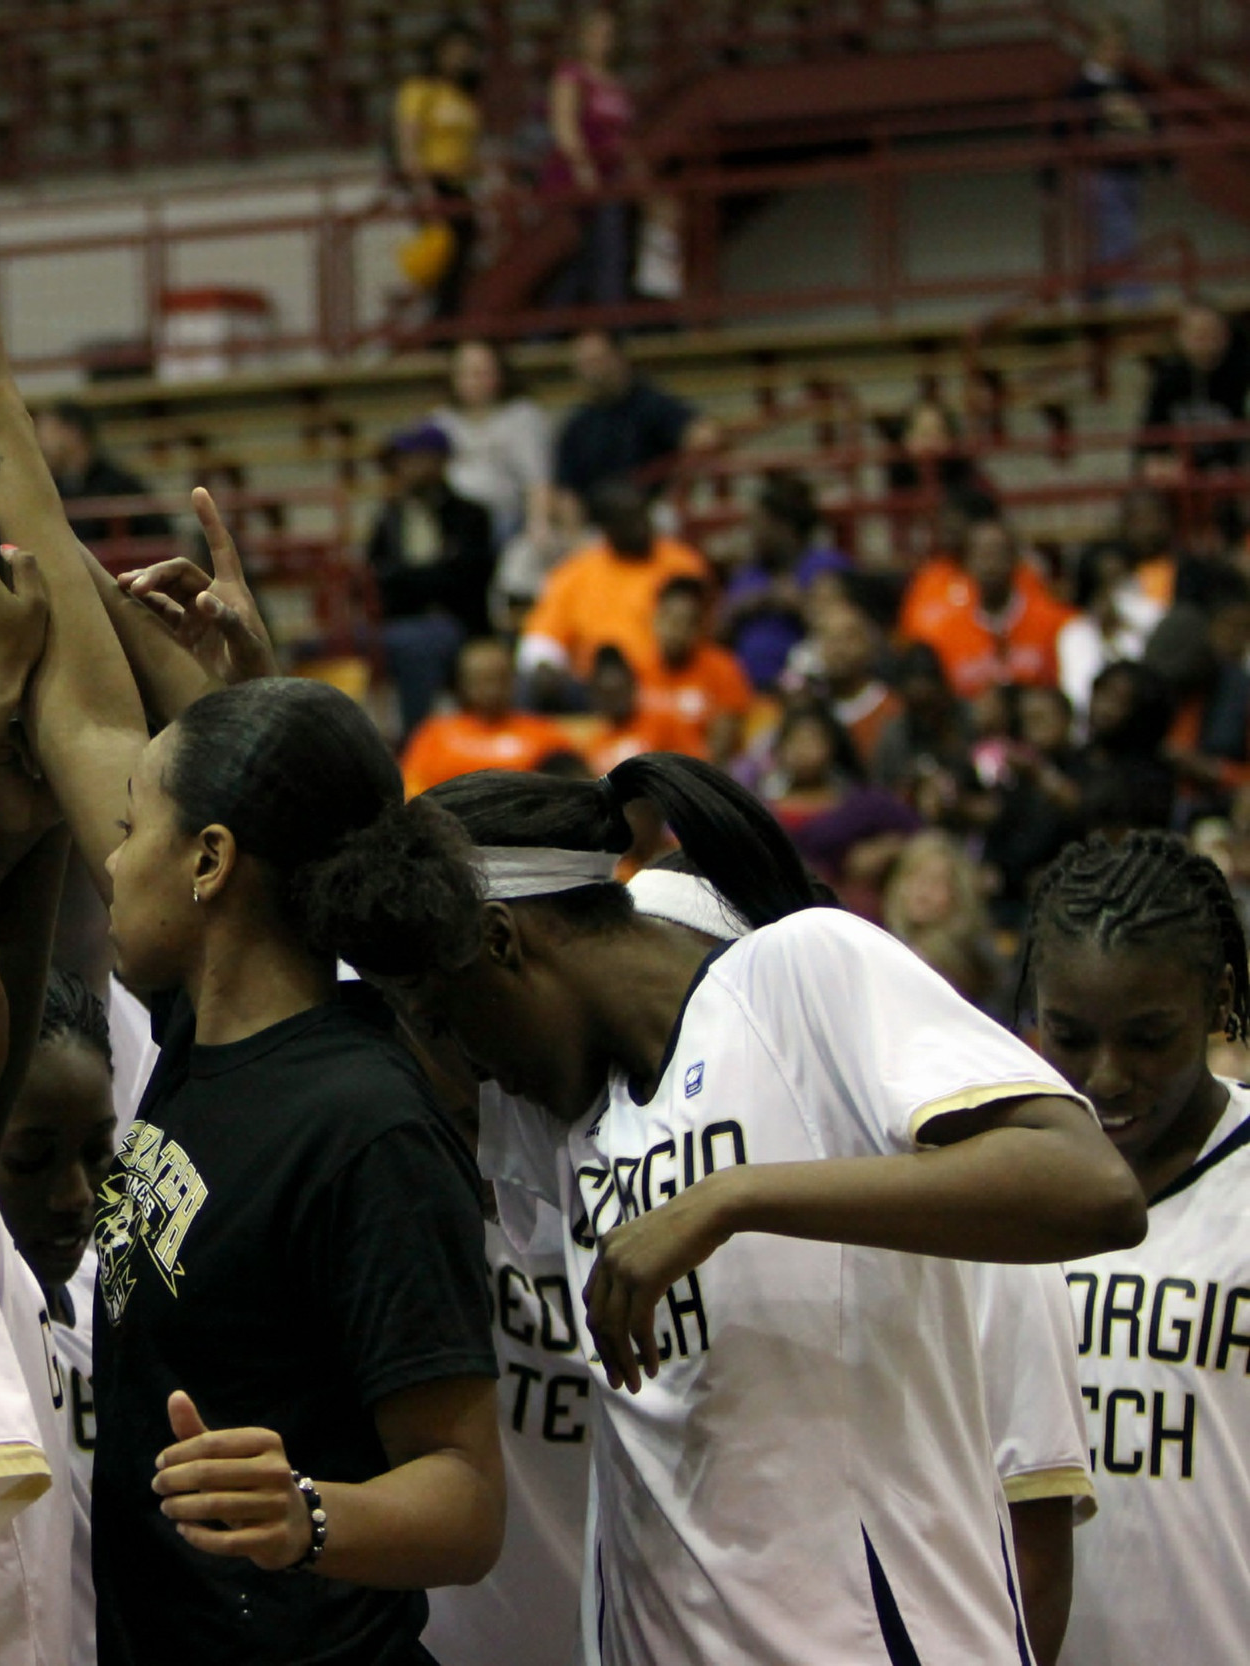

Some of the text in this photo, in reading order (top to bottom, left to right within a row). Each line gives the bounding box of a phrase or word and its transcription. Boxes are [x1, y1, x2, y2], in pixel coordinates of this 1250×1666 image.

[1064, 1271, 1250, 1376] ORGIA
[507, 1362, 590, 1444] TE
[1081, 1385, 1197, 1480] CH
